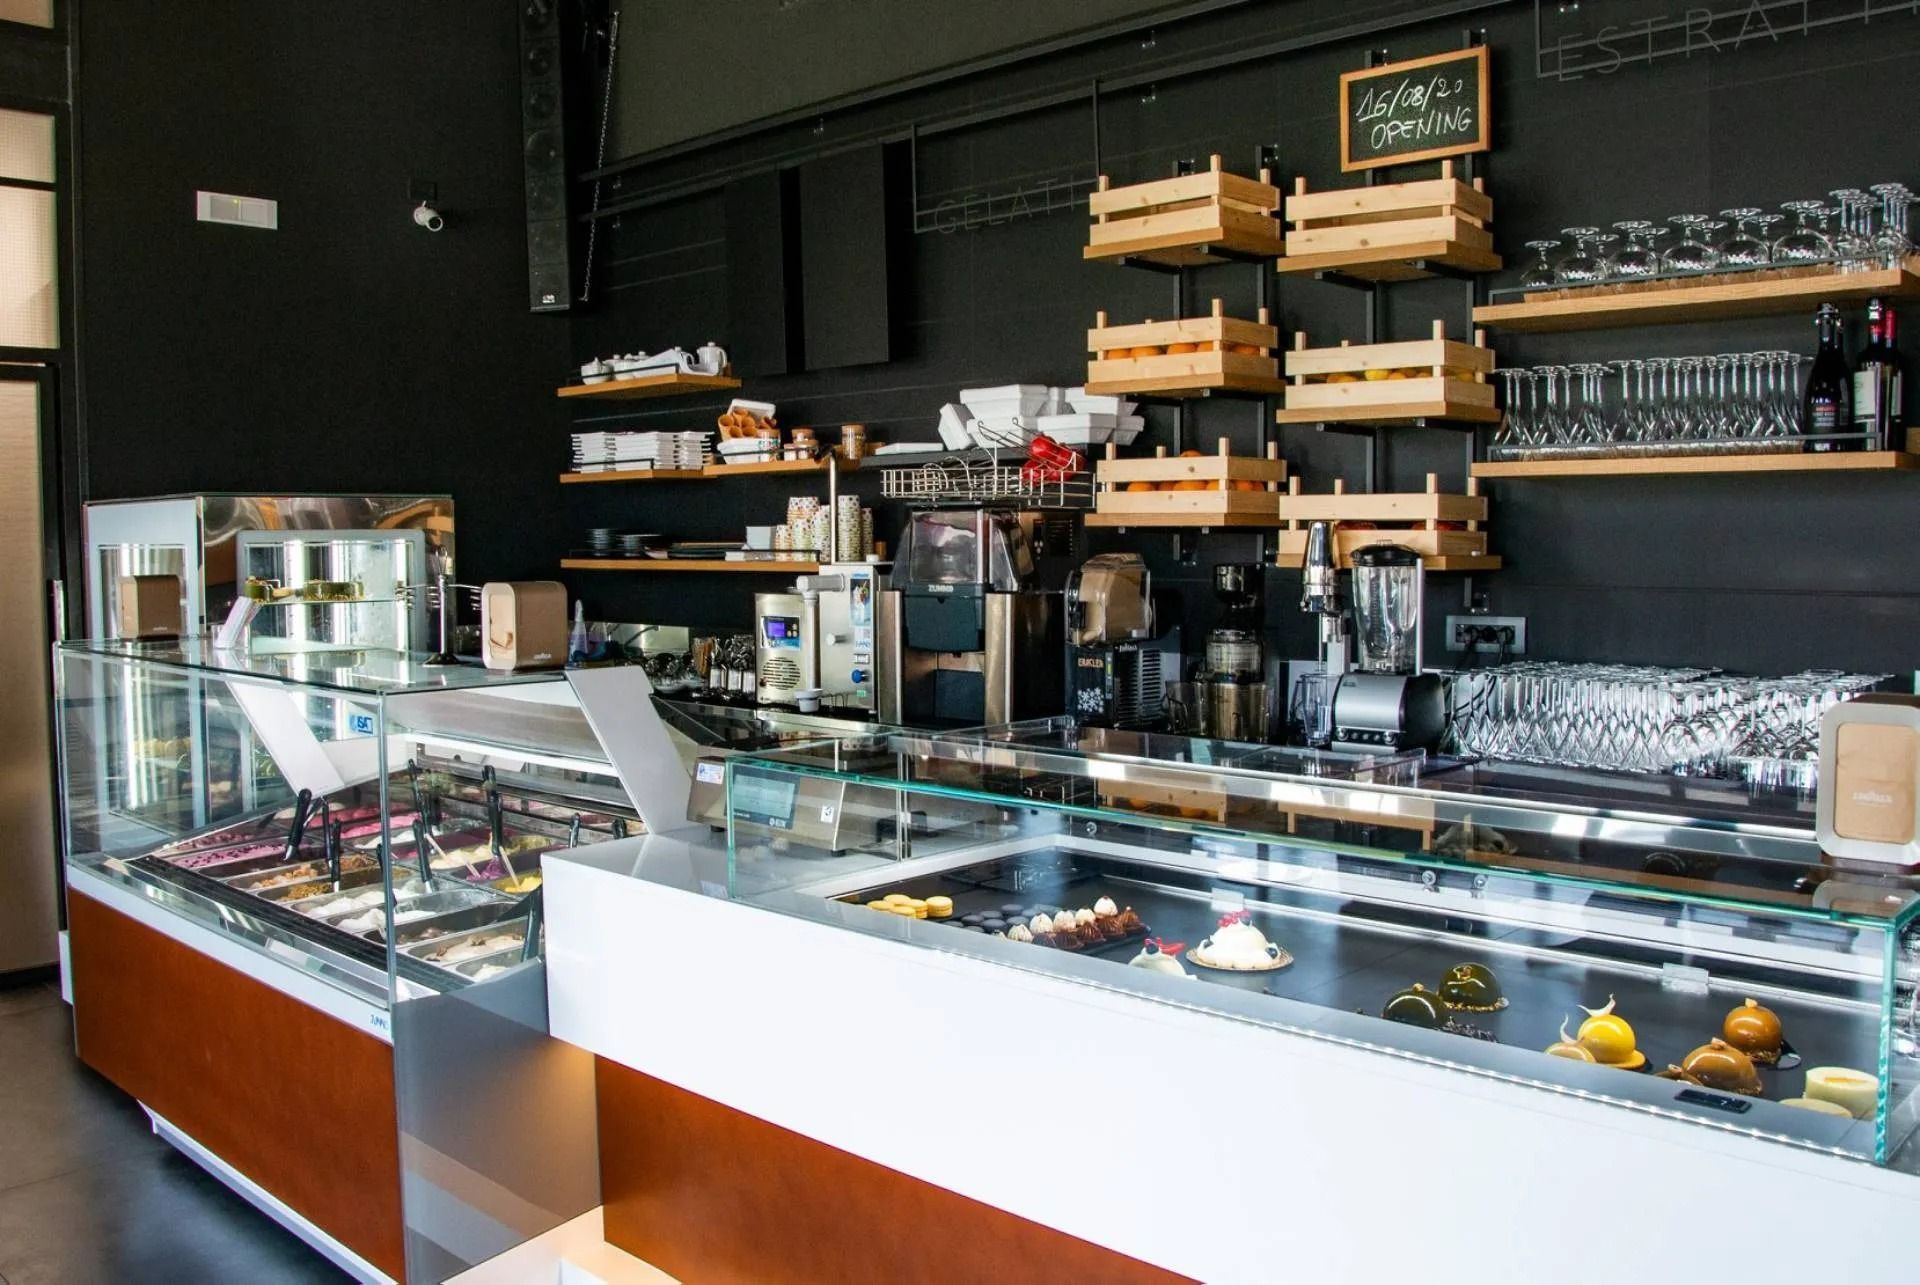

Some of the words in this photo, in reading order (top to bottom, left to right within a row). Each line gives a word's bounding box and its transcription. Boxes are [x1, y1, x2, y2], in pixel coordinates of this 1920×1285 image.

[1558, 0, 1919, 81] ESTRA
[1355, 73, 1463, 122] 16/08/20
[1371, 106, 1472, 149] OPENING
[934, 175, 1074, 234] GELATI
